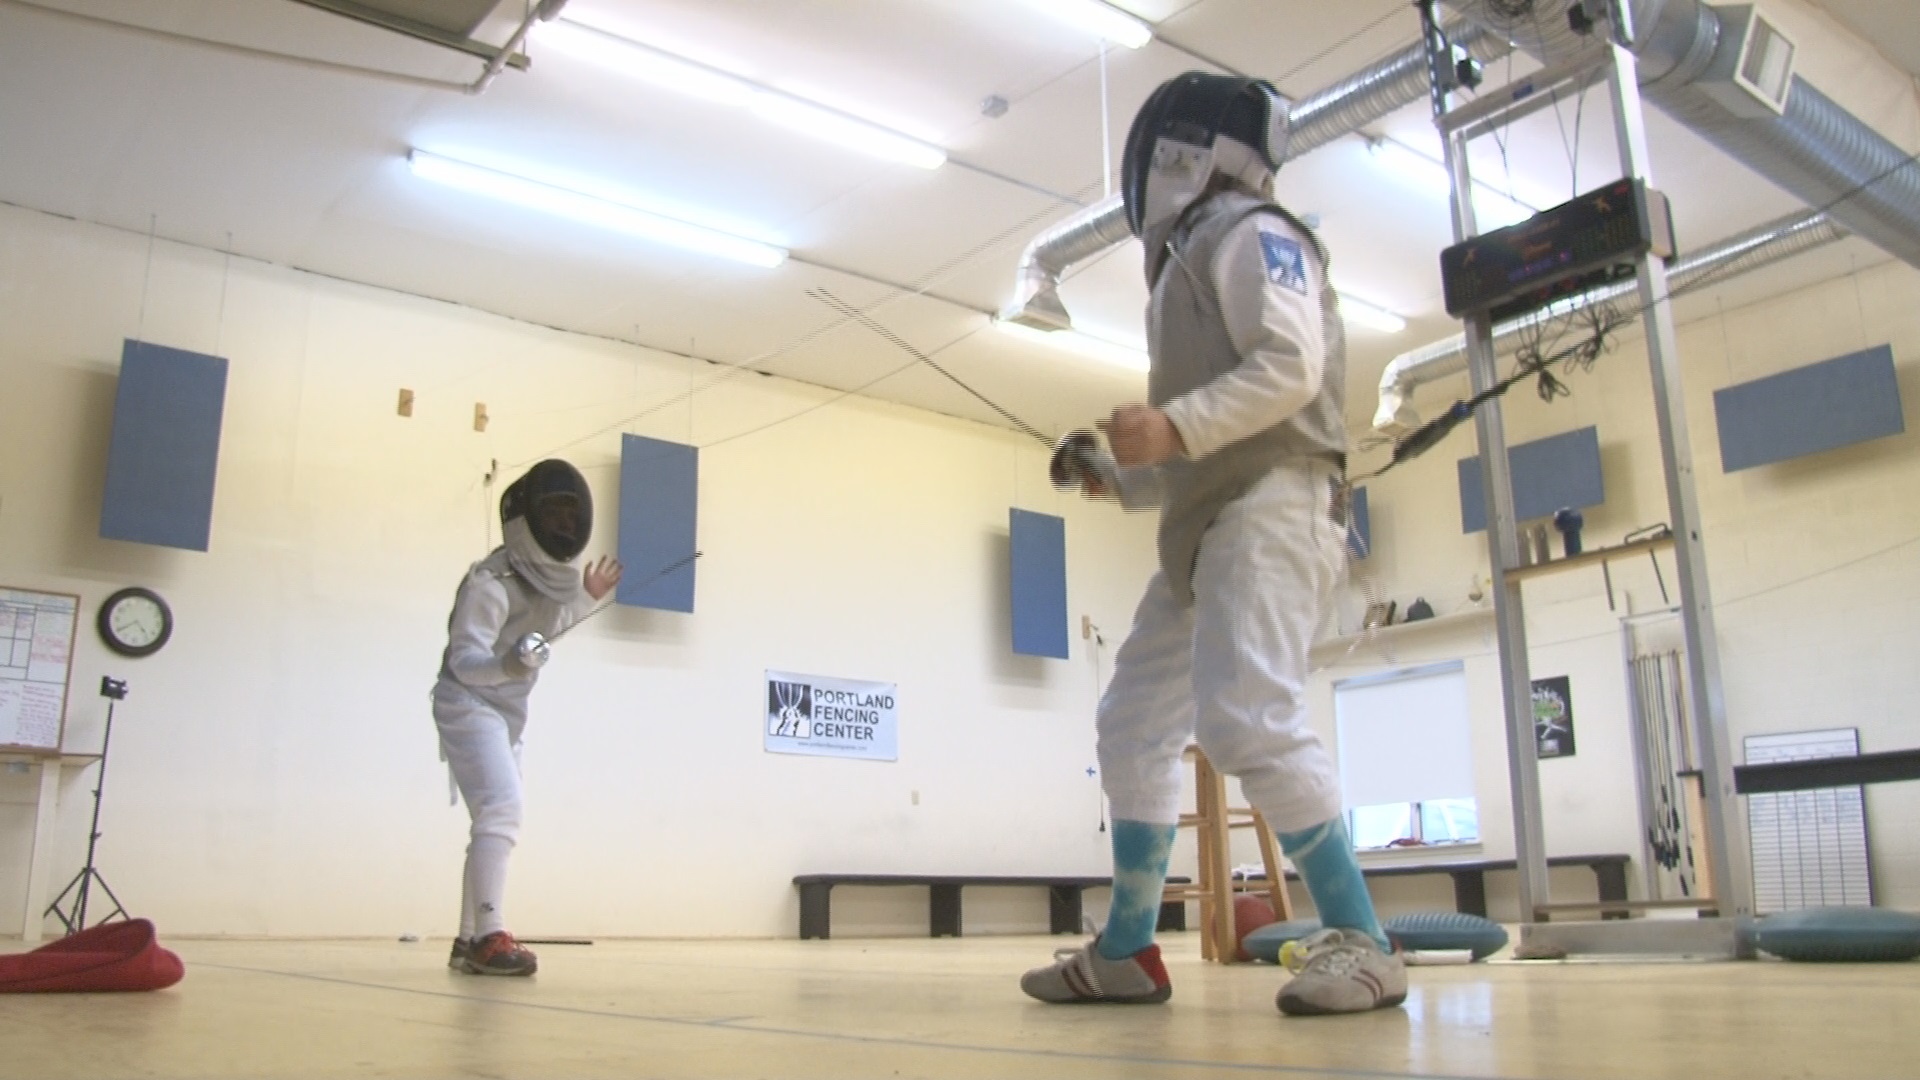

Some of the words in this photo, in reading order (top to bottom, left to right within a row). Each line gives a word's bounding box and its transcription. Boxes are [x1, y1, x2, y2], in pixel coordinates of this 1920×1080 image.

[814, 689, 894, 709] PORTLAND
[814, 705, 879, 725] FENCING
[813, 722, 873, 740] CENTER
